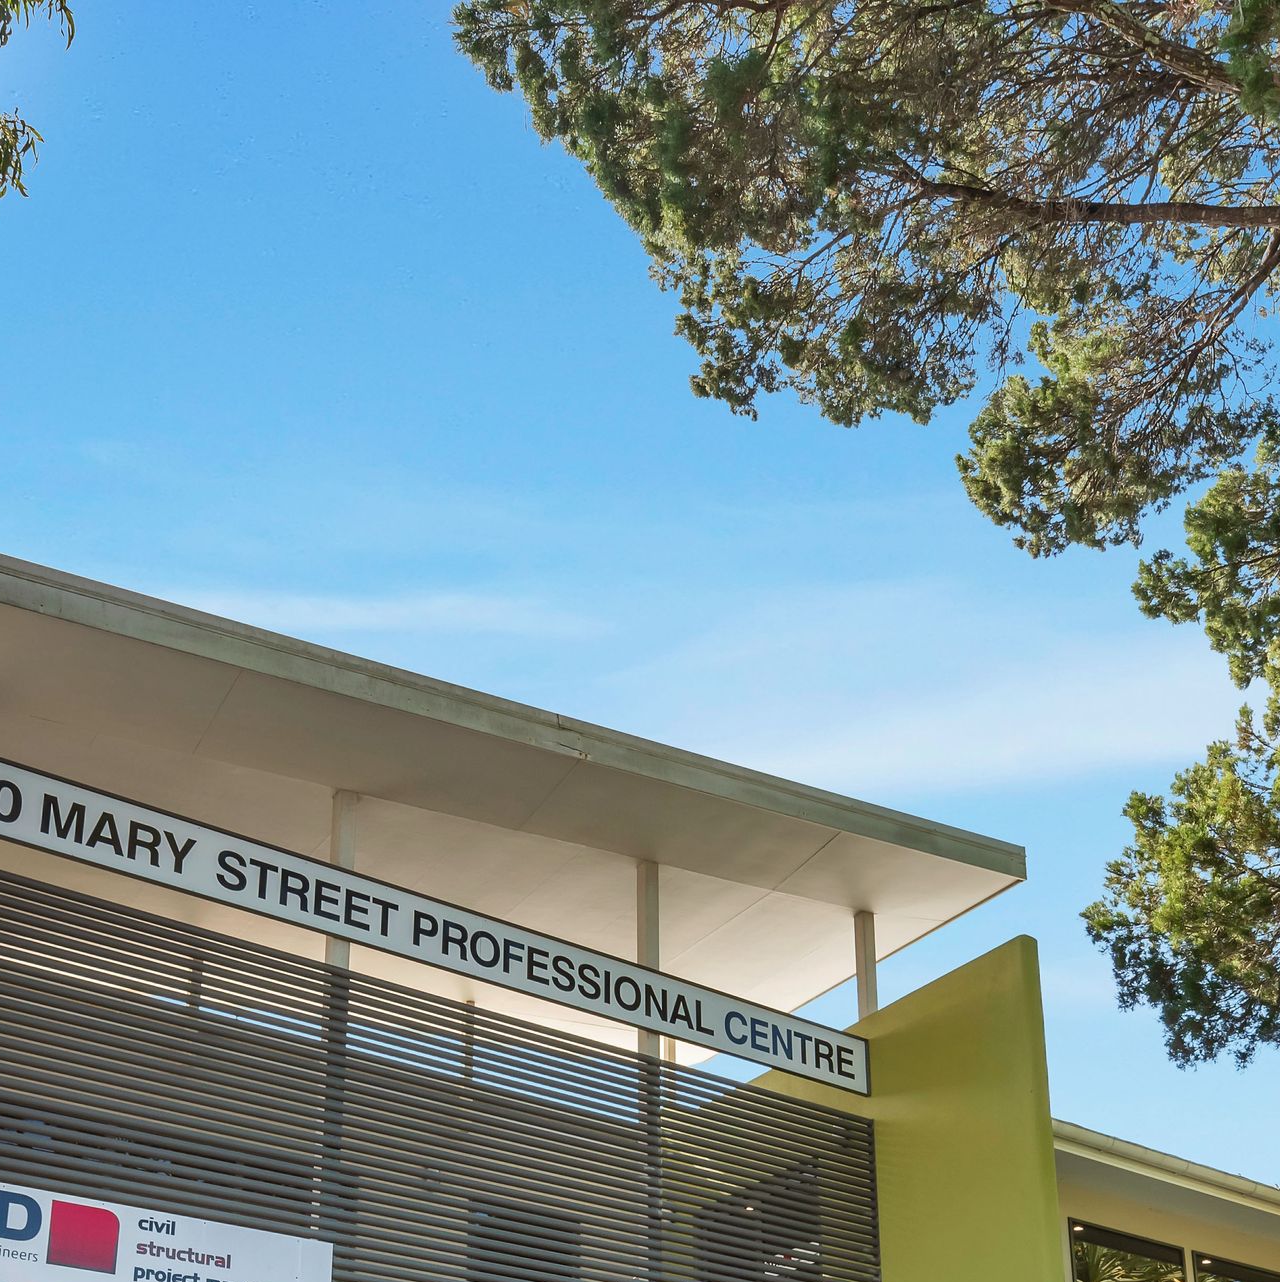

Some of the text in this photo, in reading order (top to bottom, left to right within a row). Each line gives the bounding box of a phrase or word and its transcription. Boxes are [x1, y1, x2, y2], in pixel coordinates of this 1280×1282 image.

[39, 793, 198, 875] MARY
[215, 850, 400, 938] STREET
[412, 909, 715, 1037] PROFESSIONAL
[724, 1011, 856, 1080] CENTRE
[138, 1217, 176, 1236] civil
[136, 1241, 232, 1269] structural
